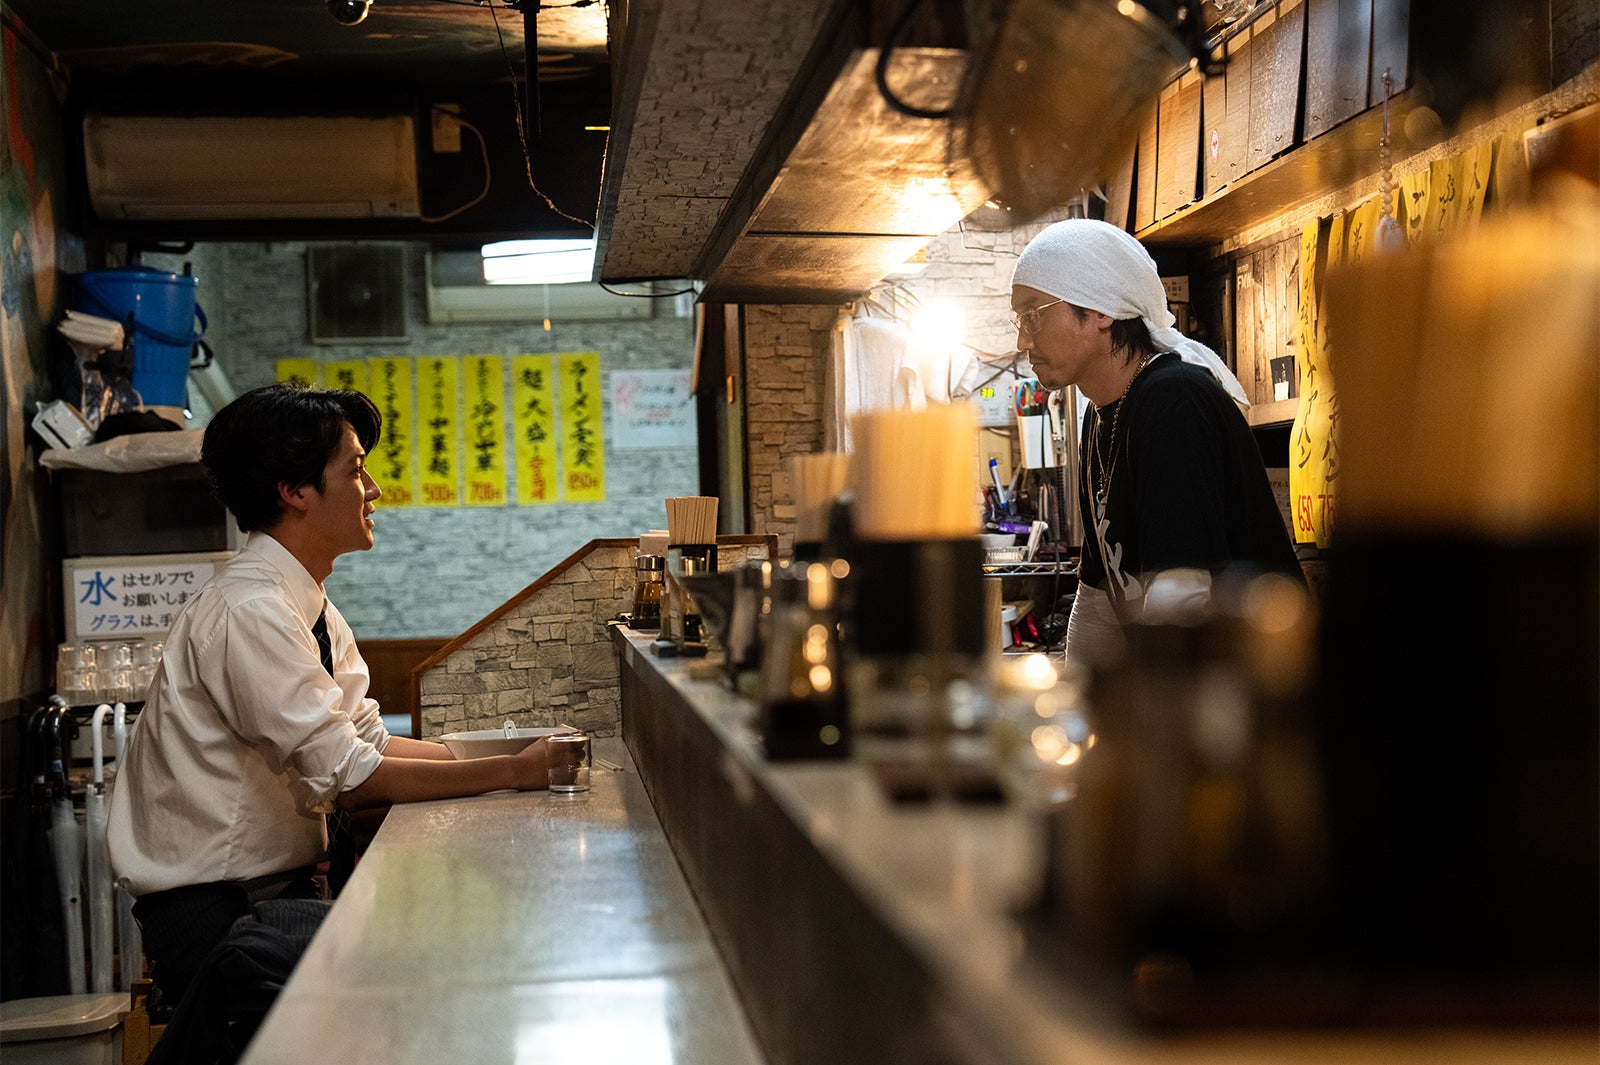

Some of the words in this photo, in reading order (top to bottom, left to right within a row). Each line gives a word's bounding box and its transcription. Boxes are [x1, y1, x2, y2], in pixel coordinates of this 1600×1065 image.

[981, 387, 995, 399] 38
[79, 570, 118, 606] 水
[122, 570, 195, 588] はセルフで
